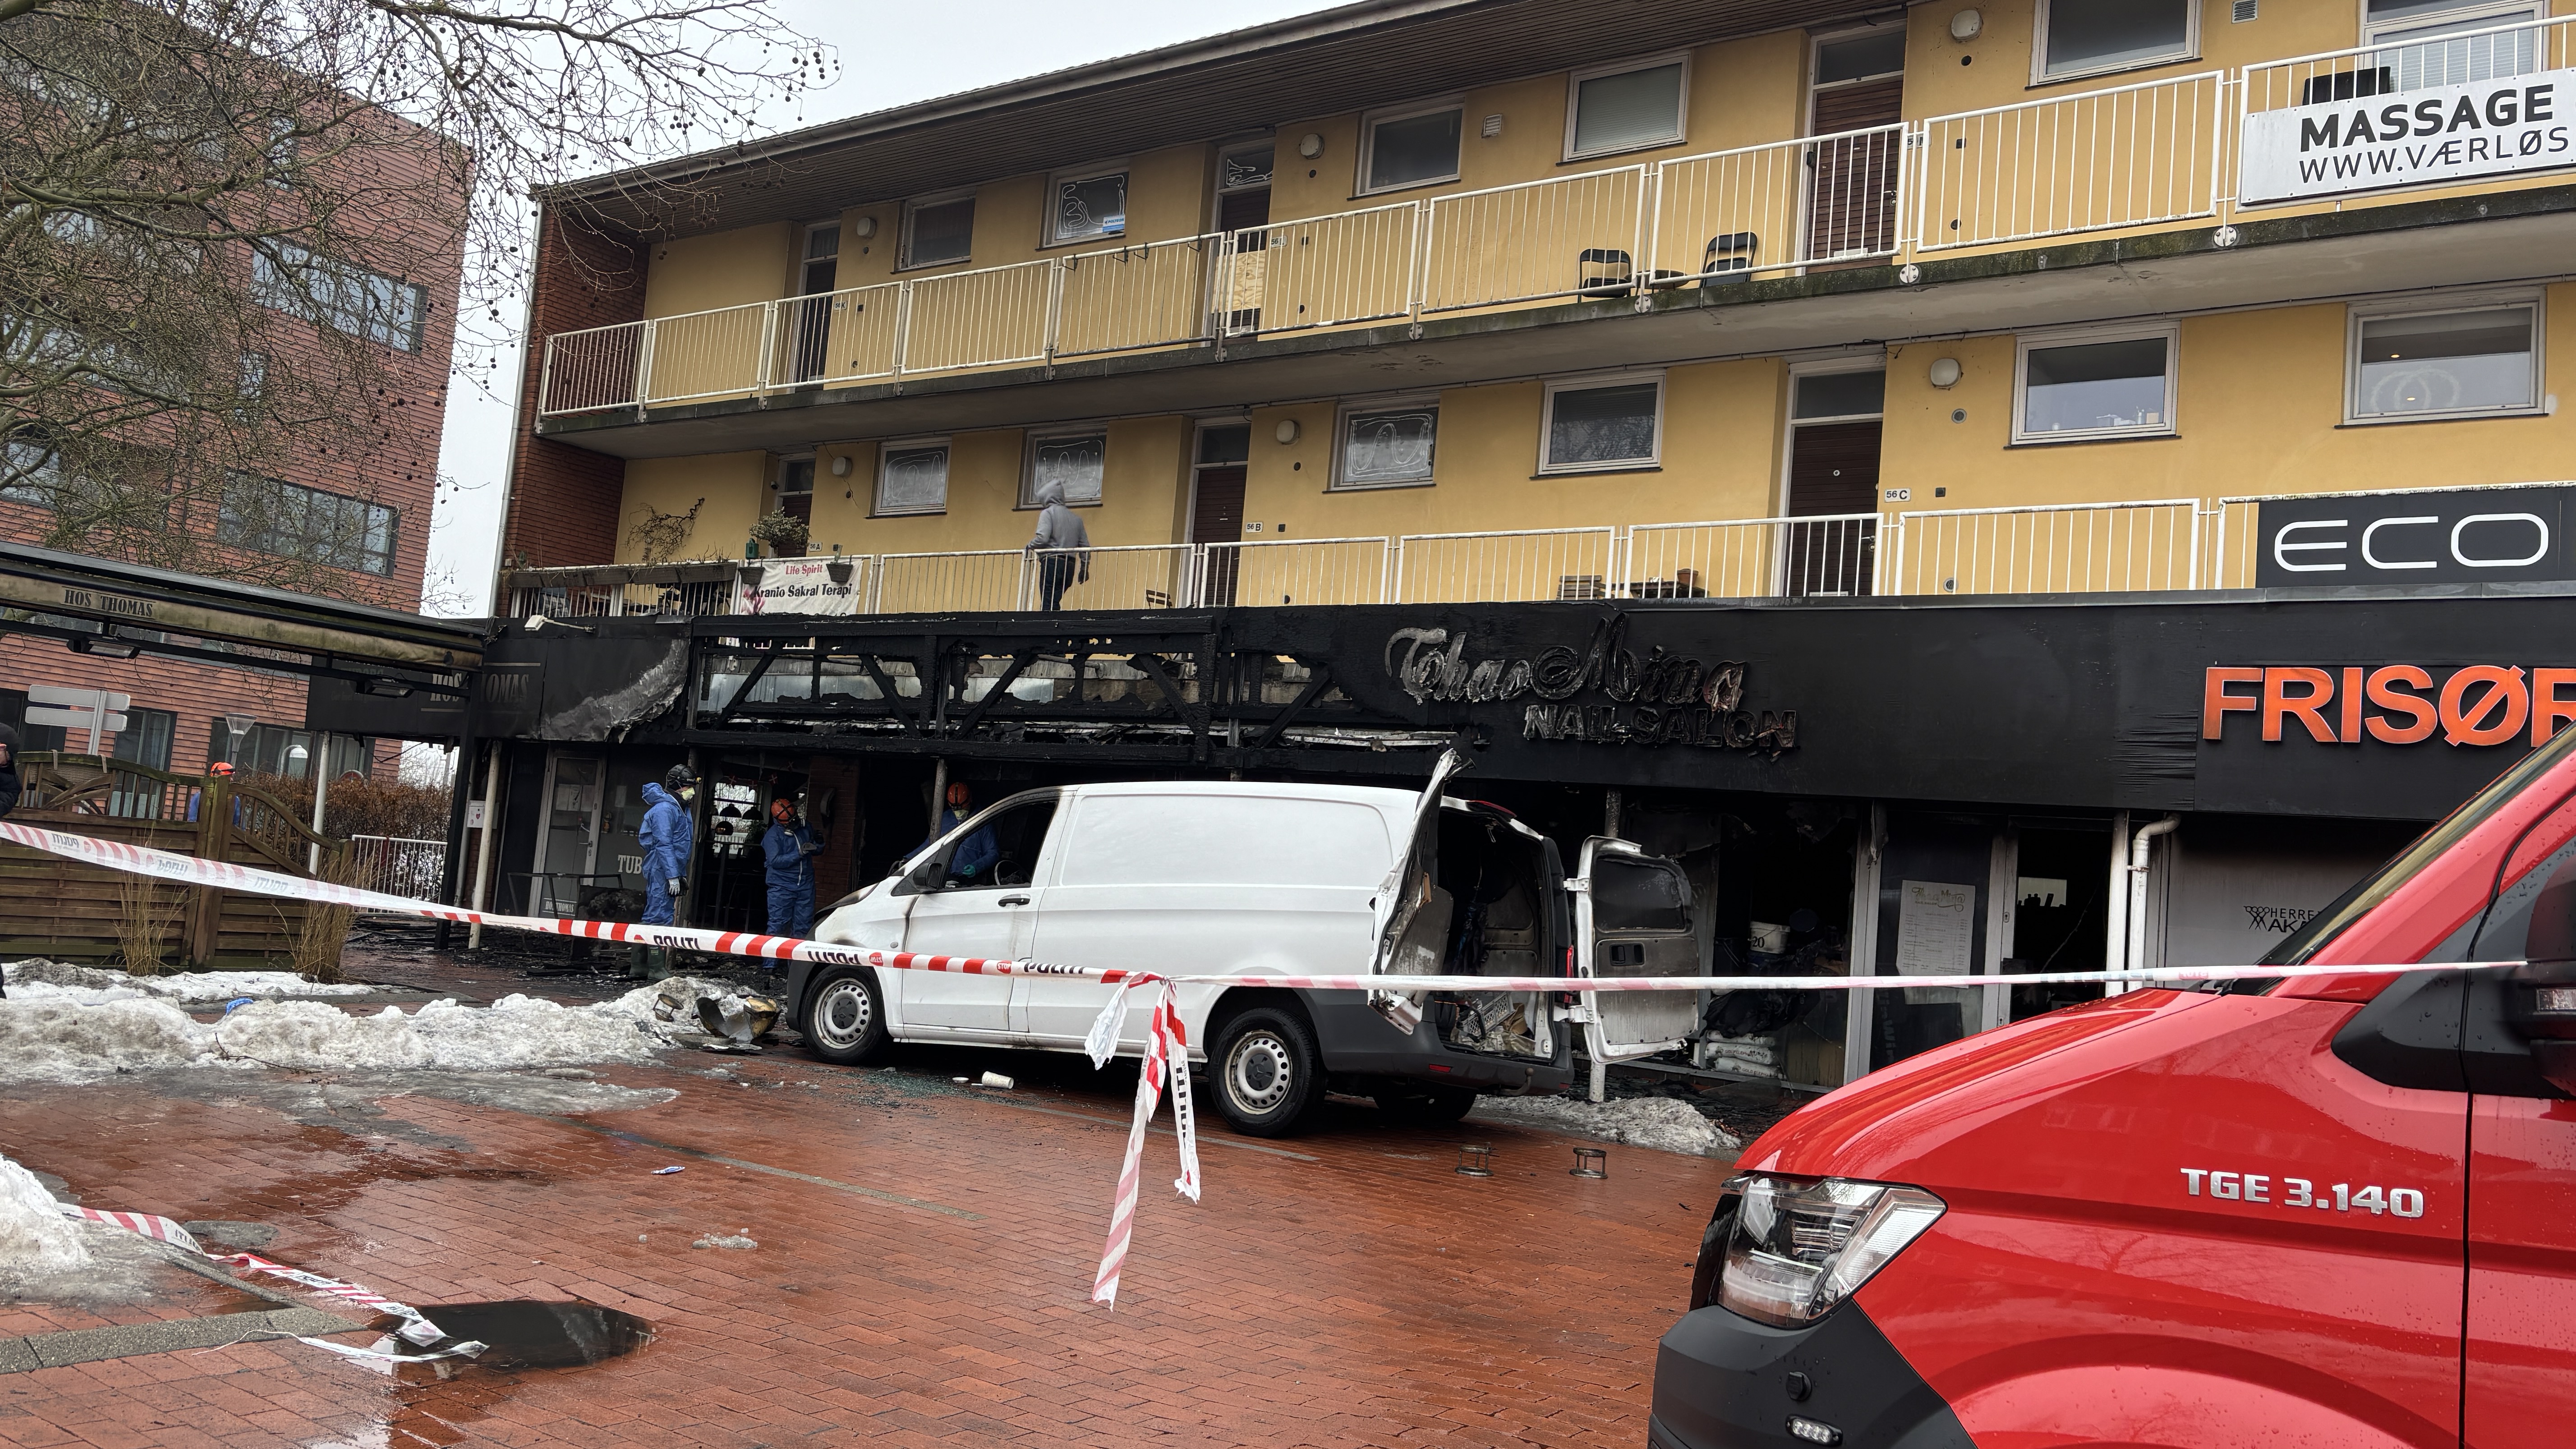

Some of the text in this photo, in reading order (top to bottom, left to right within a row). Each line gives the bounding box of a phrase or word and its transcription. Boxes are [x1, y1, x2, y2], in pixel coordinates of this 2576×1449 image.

[2300, 84, 2553, 152] MASSAGE
[2300, 127, 2569, 184] WWW.VÆRLØS
[1900, 490, 1907, 500] C
[2275, 513, 2548, 571] ECO
[786, 564, 823, 576] Life Spirit
[754, 583, 852, 598] Kranio Sakral Terapi
[64, 589, 152, 617] HOS THOMAS
[1629, 706, 1799, 749] SALON
[2271, 907, 2320, 920] HERRE
[653, 935, 700, 950] POLITI
[1753, 936, 1765, 948] 20
